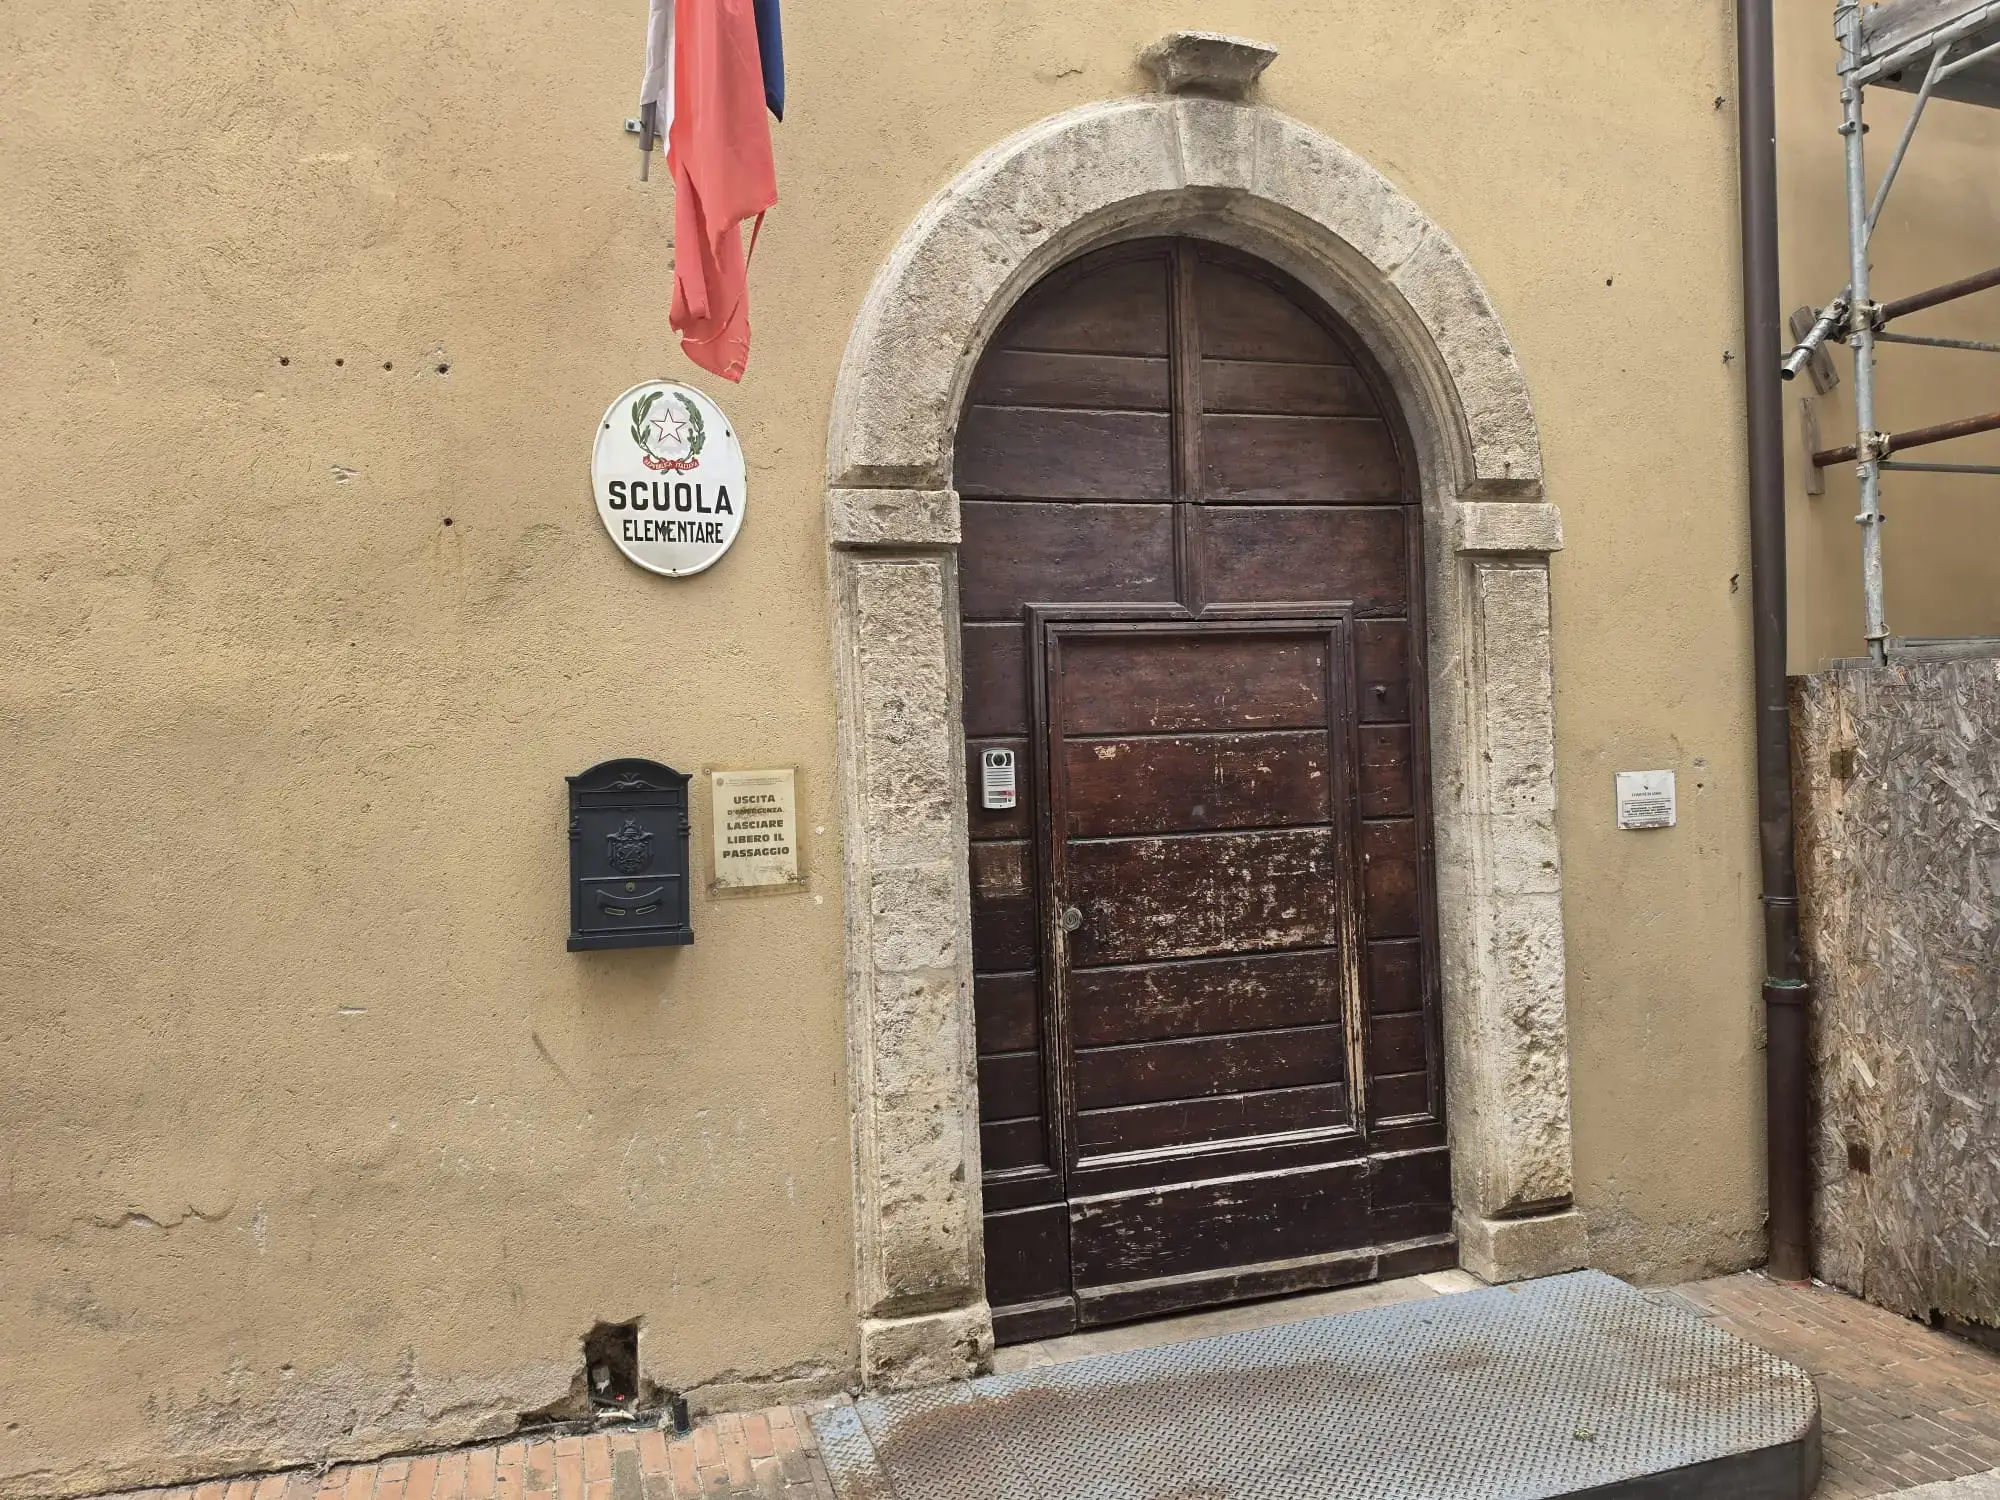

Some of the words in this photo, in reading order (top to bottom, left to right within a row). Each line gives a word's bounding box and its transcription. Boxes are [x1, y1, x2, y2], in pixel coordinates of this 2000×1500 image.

[608, 480, 733, 515] SCUOLA
[623, 519, 724, 543] ELEMENTARE
[733, 794, 776, 805] USCITA
[727, 819, 784, 831] LASCIARE
[727, 834, 770, 844] LIBERO
[773, 833, 784, 842] IL
[722, 846, 790, 859] PASSAGGIO
